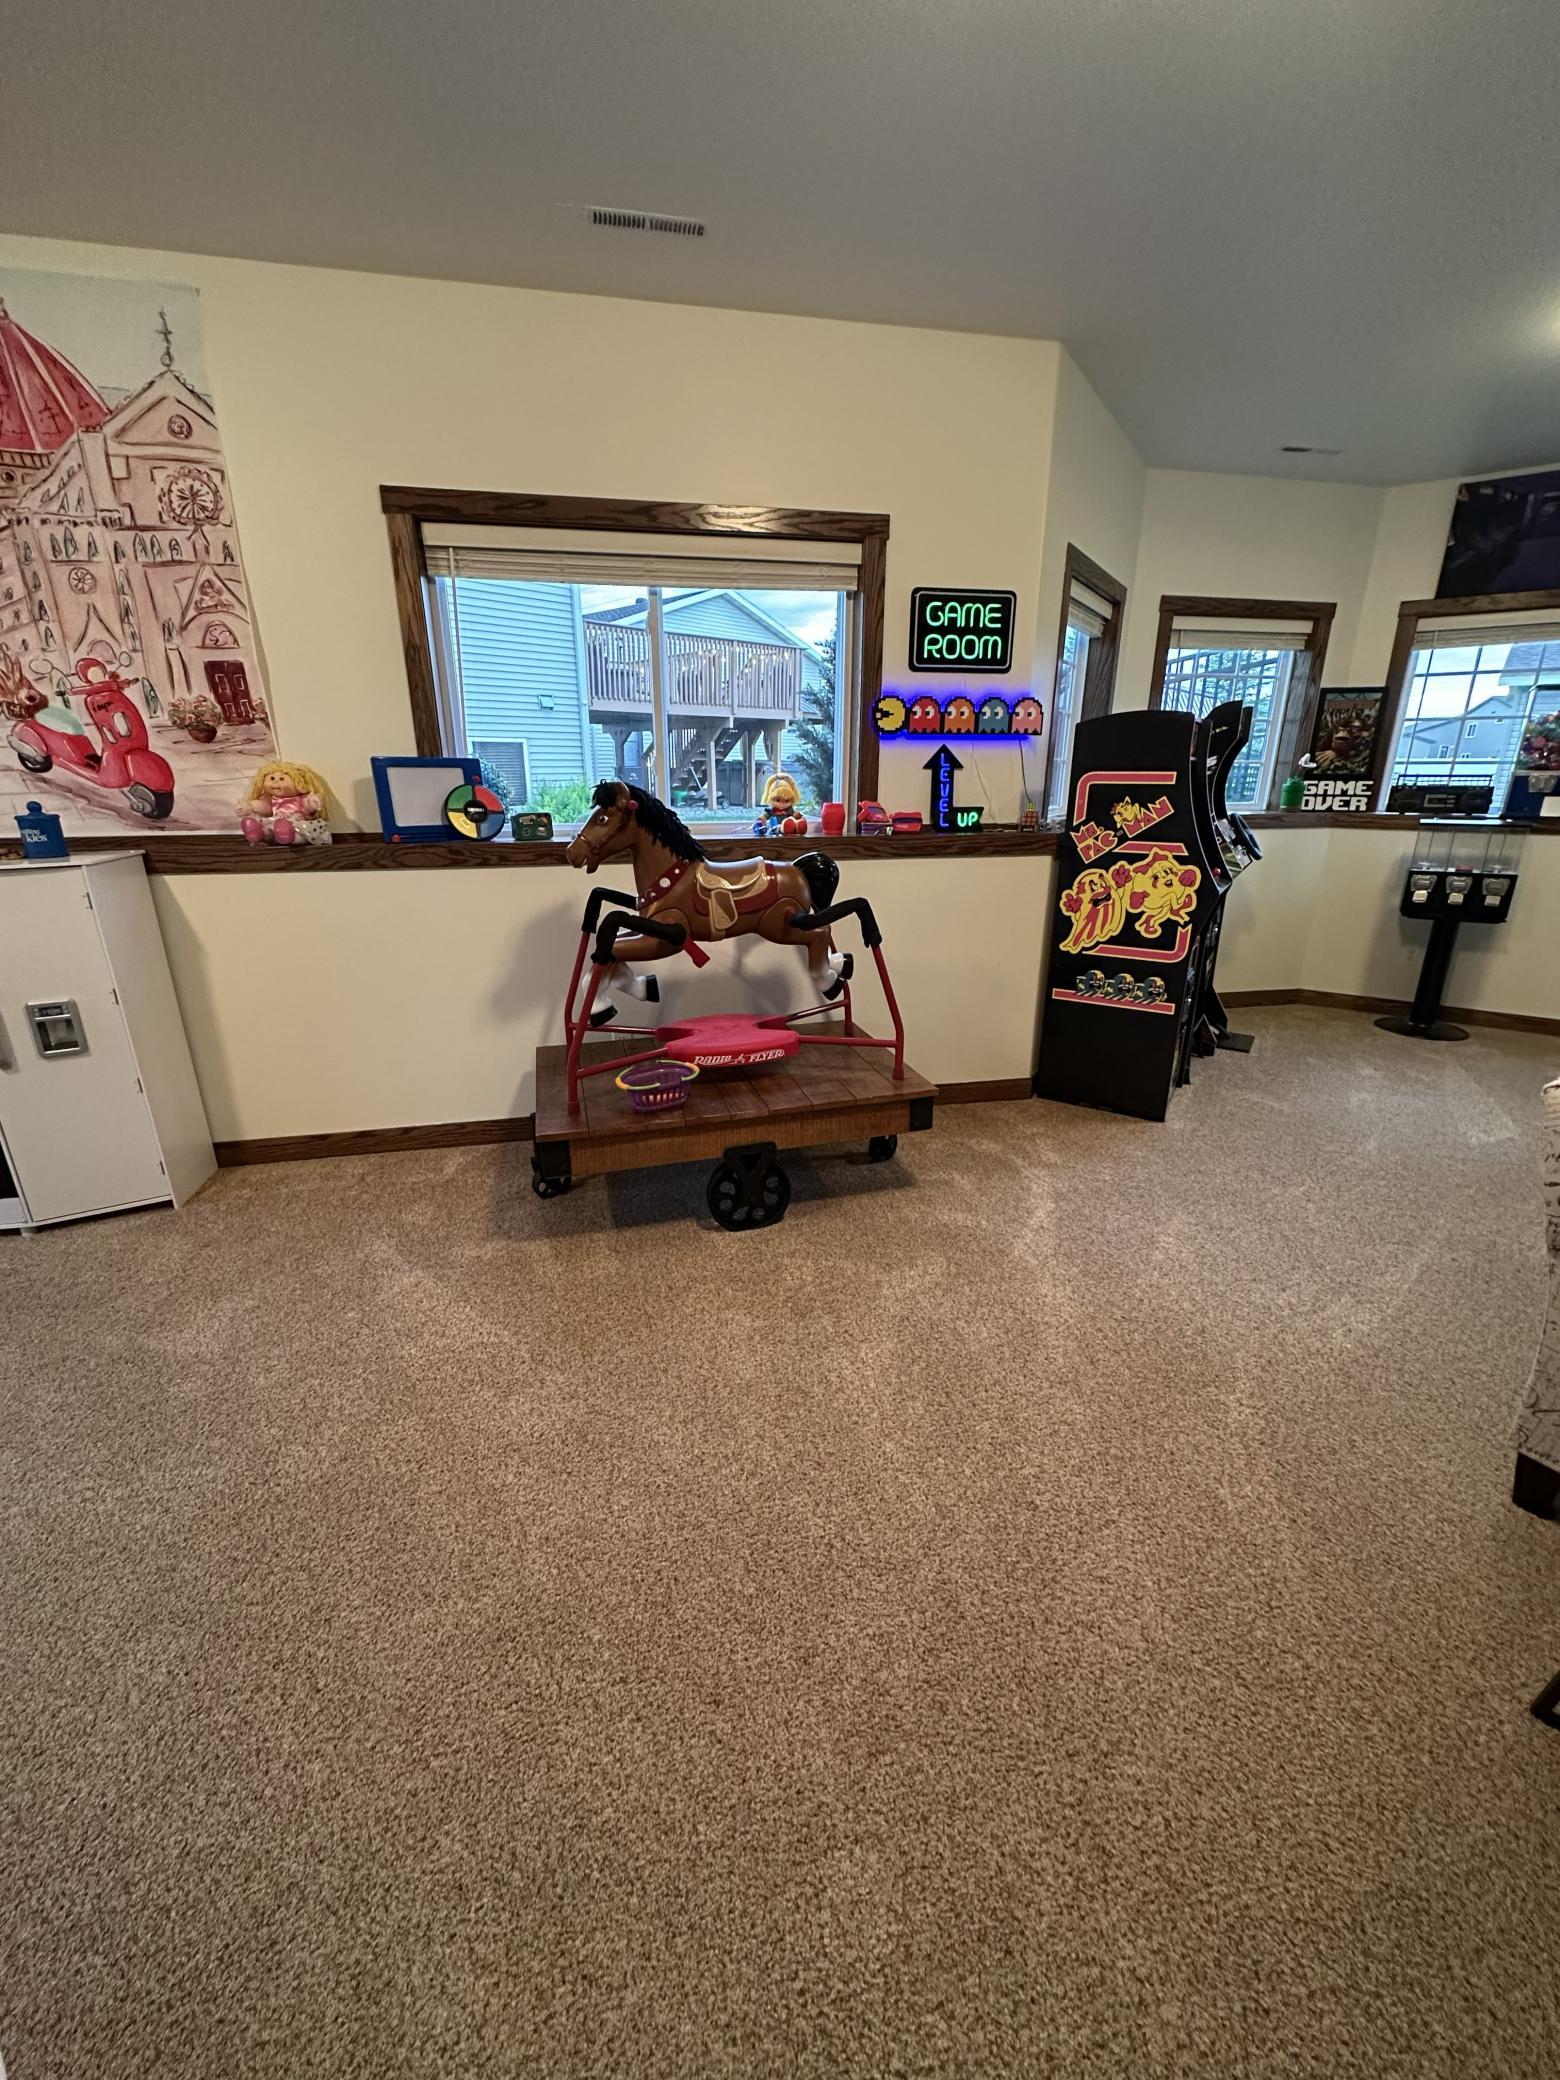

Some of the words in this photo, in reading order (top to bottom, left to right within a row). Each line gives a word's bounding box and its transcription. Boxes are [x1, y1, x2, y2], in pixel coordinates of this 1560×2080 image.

[926, 601, 1002, 628] GAME
[923, 633, 1002, 660] ROOM
[939, 752, 950, 828] LEVEL
[1303, 780, 1374, 796] GAME
[1300, 796, 1369, 812] OVER
[956, 811, 979, 828] UP
[693, 1055, 736, 1067] RADIO
[745, 1048, 786, 1063] FLYER
